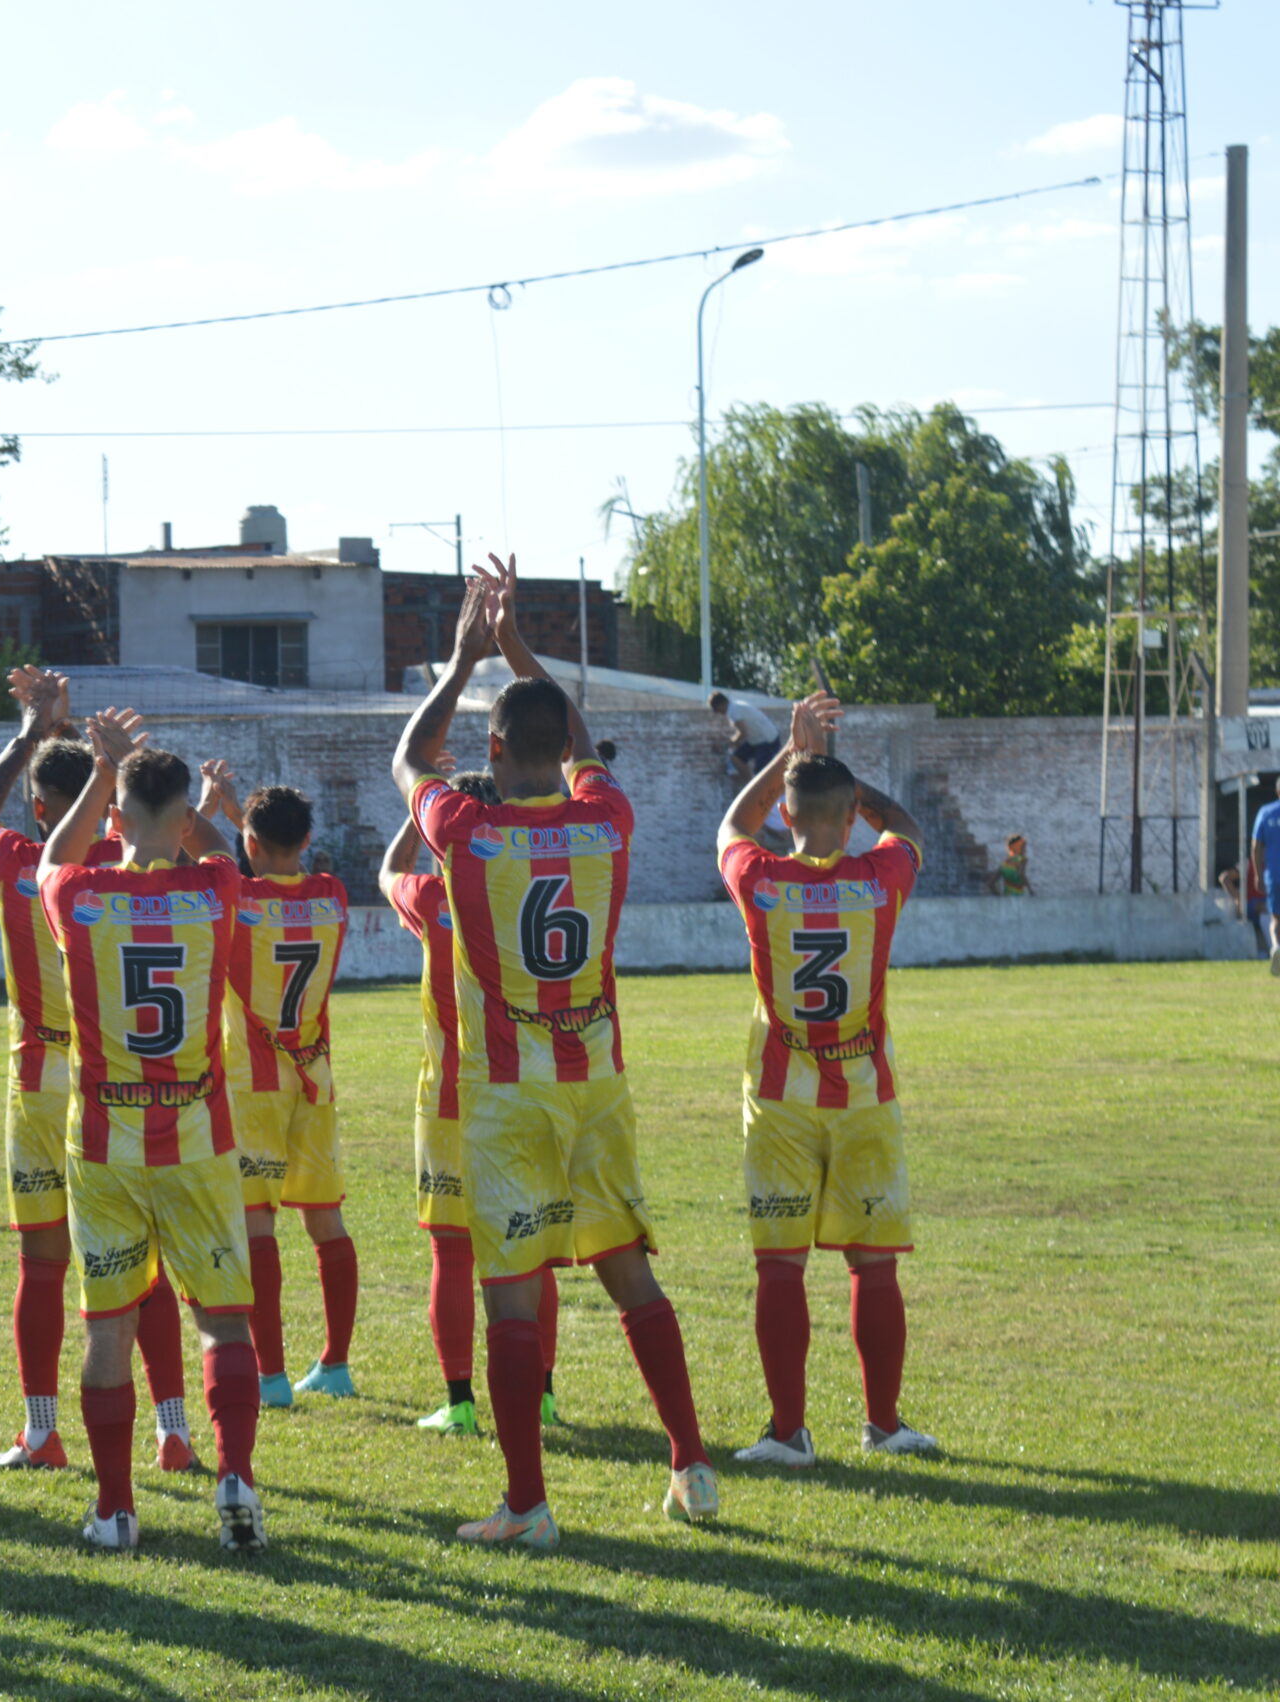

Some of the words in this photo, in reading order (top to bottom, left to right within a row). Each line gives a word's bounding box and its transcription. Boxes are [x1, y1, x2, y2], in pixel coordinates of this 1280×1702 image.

[510, 820, 620, 850] CODESAL
[110, 888, 223, 915] CODESAL
[784, 878, 888, 903] CODESAL
[518, 874, 591, 981] 6
[118, 943, 187, 1058] 5
[273, 940, 323, 1032] 7
[791, 928, 850, 1022] 3
[97, 1081, 155, 1107] CLUB
